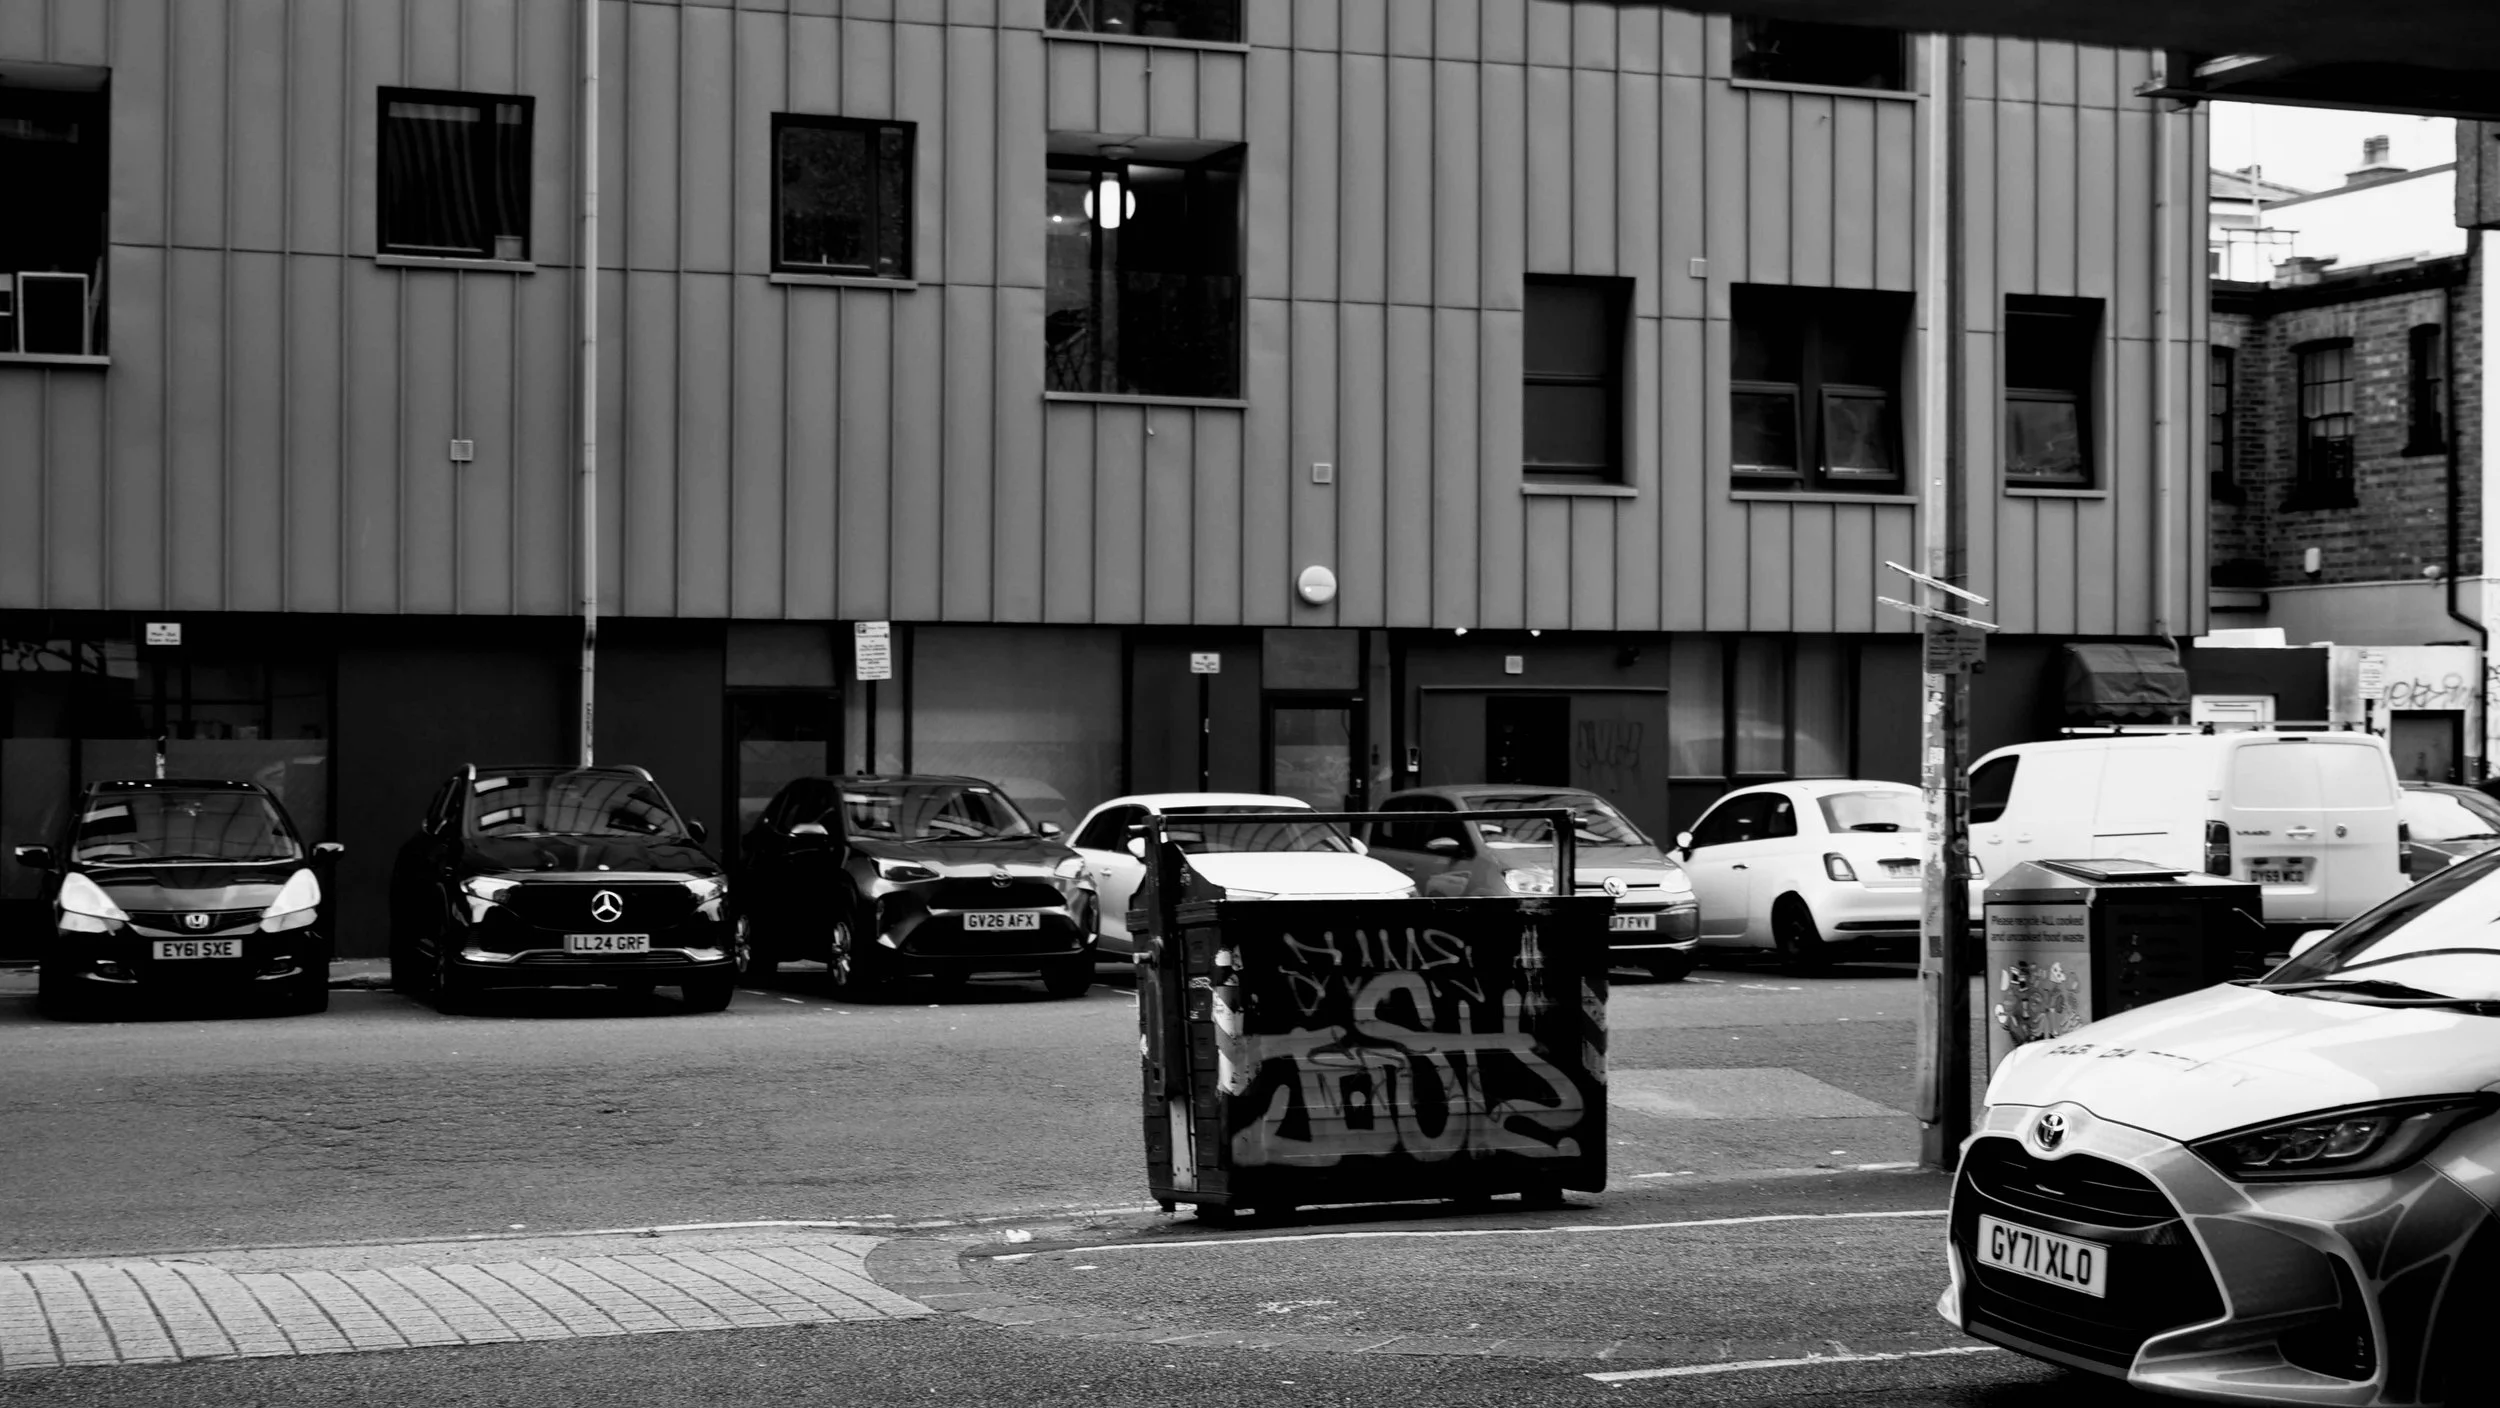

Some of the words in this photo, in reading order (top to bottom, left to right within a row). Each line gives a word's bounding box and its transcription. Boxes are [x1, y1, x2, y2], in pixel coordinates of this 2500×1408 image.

[968, 914, 1004, 928] GV26
[1008, 914, 1034, 927] AFX
[1991, 915, 2014, 926] Please
[2014, 915, 2040, 928] recycle
[2042, 915, 2055, 926] ALL
[2056, 914, 2084, 926] cooked
[574, 936, 613, 951] LL24
[617, 936, 647, 950] GRF
[1991, 931, 2005, 942] and
[2006, 931, 2041, 942] uncooked
[2042, 931, 2061, 942] food
[2062, 933, 2085, 943] waste
[163, 942, 198, 957] EY61
[202, 942, 233, 956] SXE
[1992, 1225, 2039, 1271] GY71
[2045, 1239, 2091, 1285] XLO
